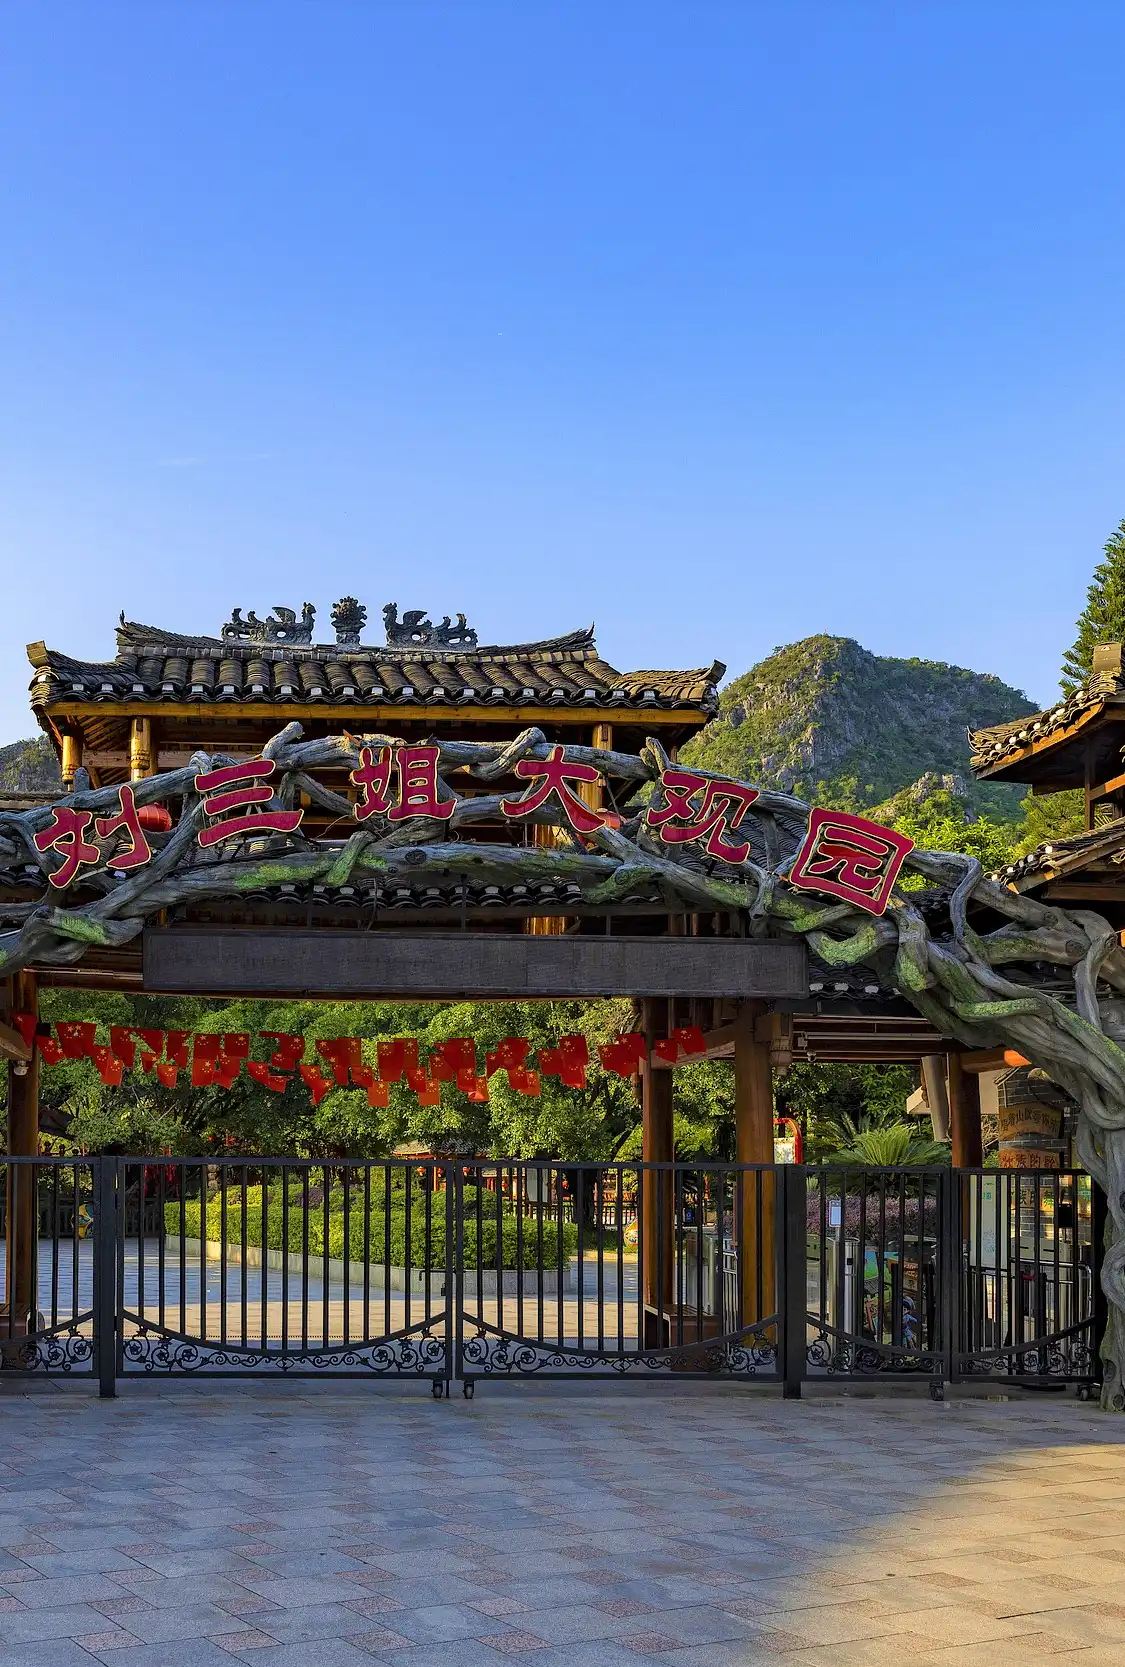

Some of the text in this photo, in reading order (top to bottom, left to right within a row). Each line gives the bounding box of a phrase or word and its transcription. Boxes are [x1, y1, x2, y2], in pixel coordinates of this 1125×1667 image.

[34, 745, 916, 917] 刘三姐大观园
